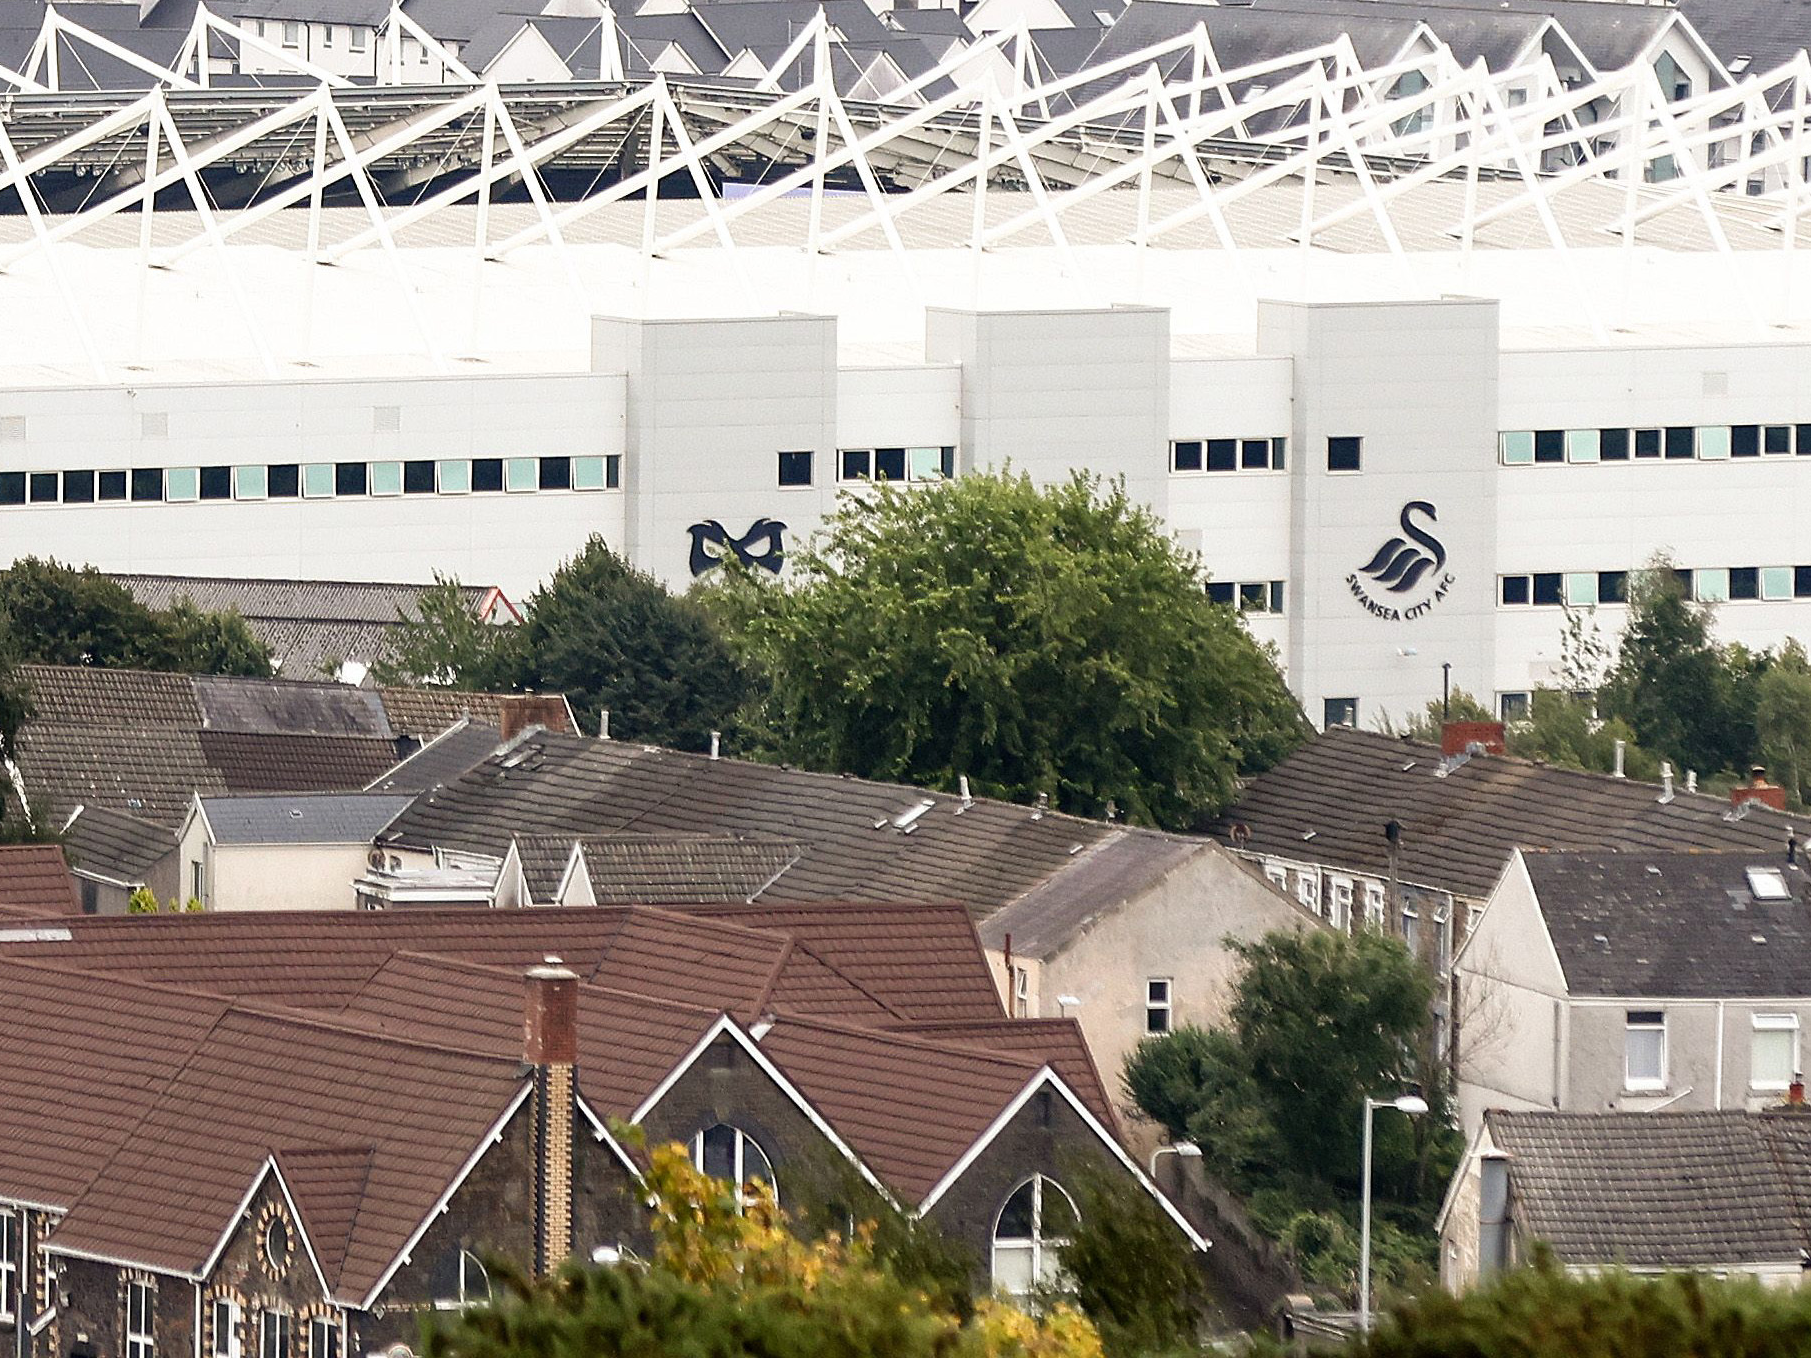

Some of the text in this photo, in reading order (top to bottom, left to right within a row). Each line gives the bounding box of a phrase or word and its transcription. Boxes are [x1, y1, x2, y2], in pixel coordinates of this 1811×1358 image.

[1345, 572, 1456, 622] SWANSEA CITY AFC
